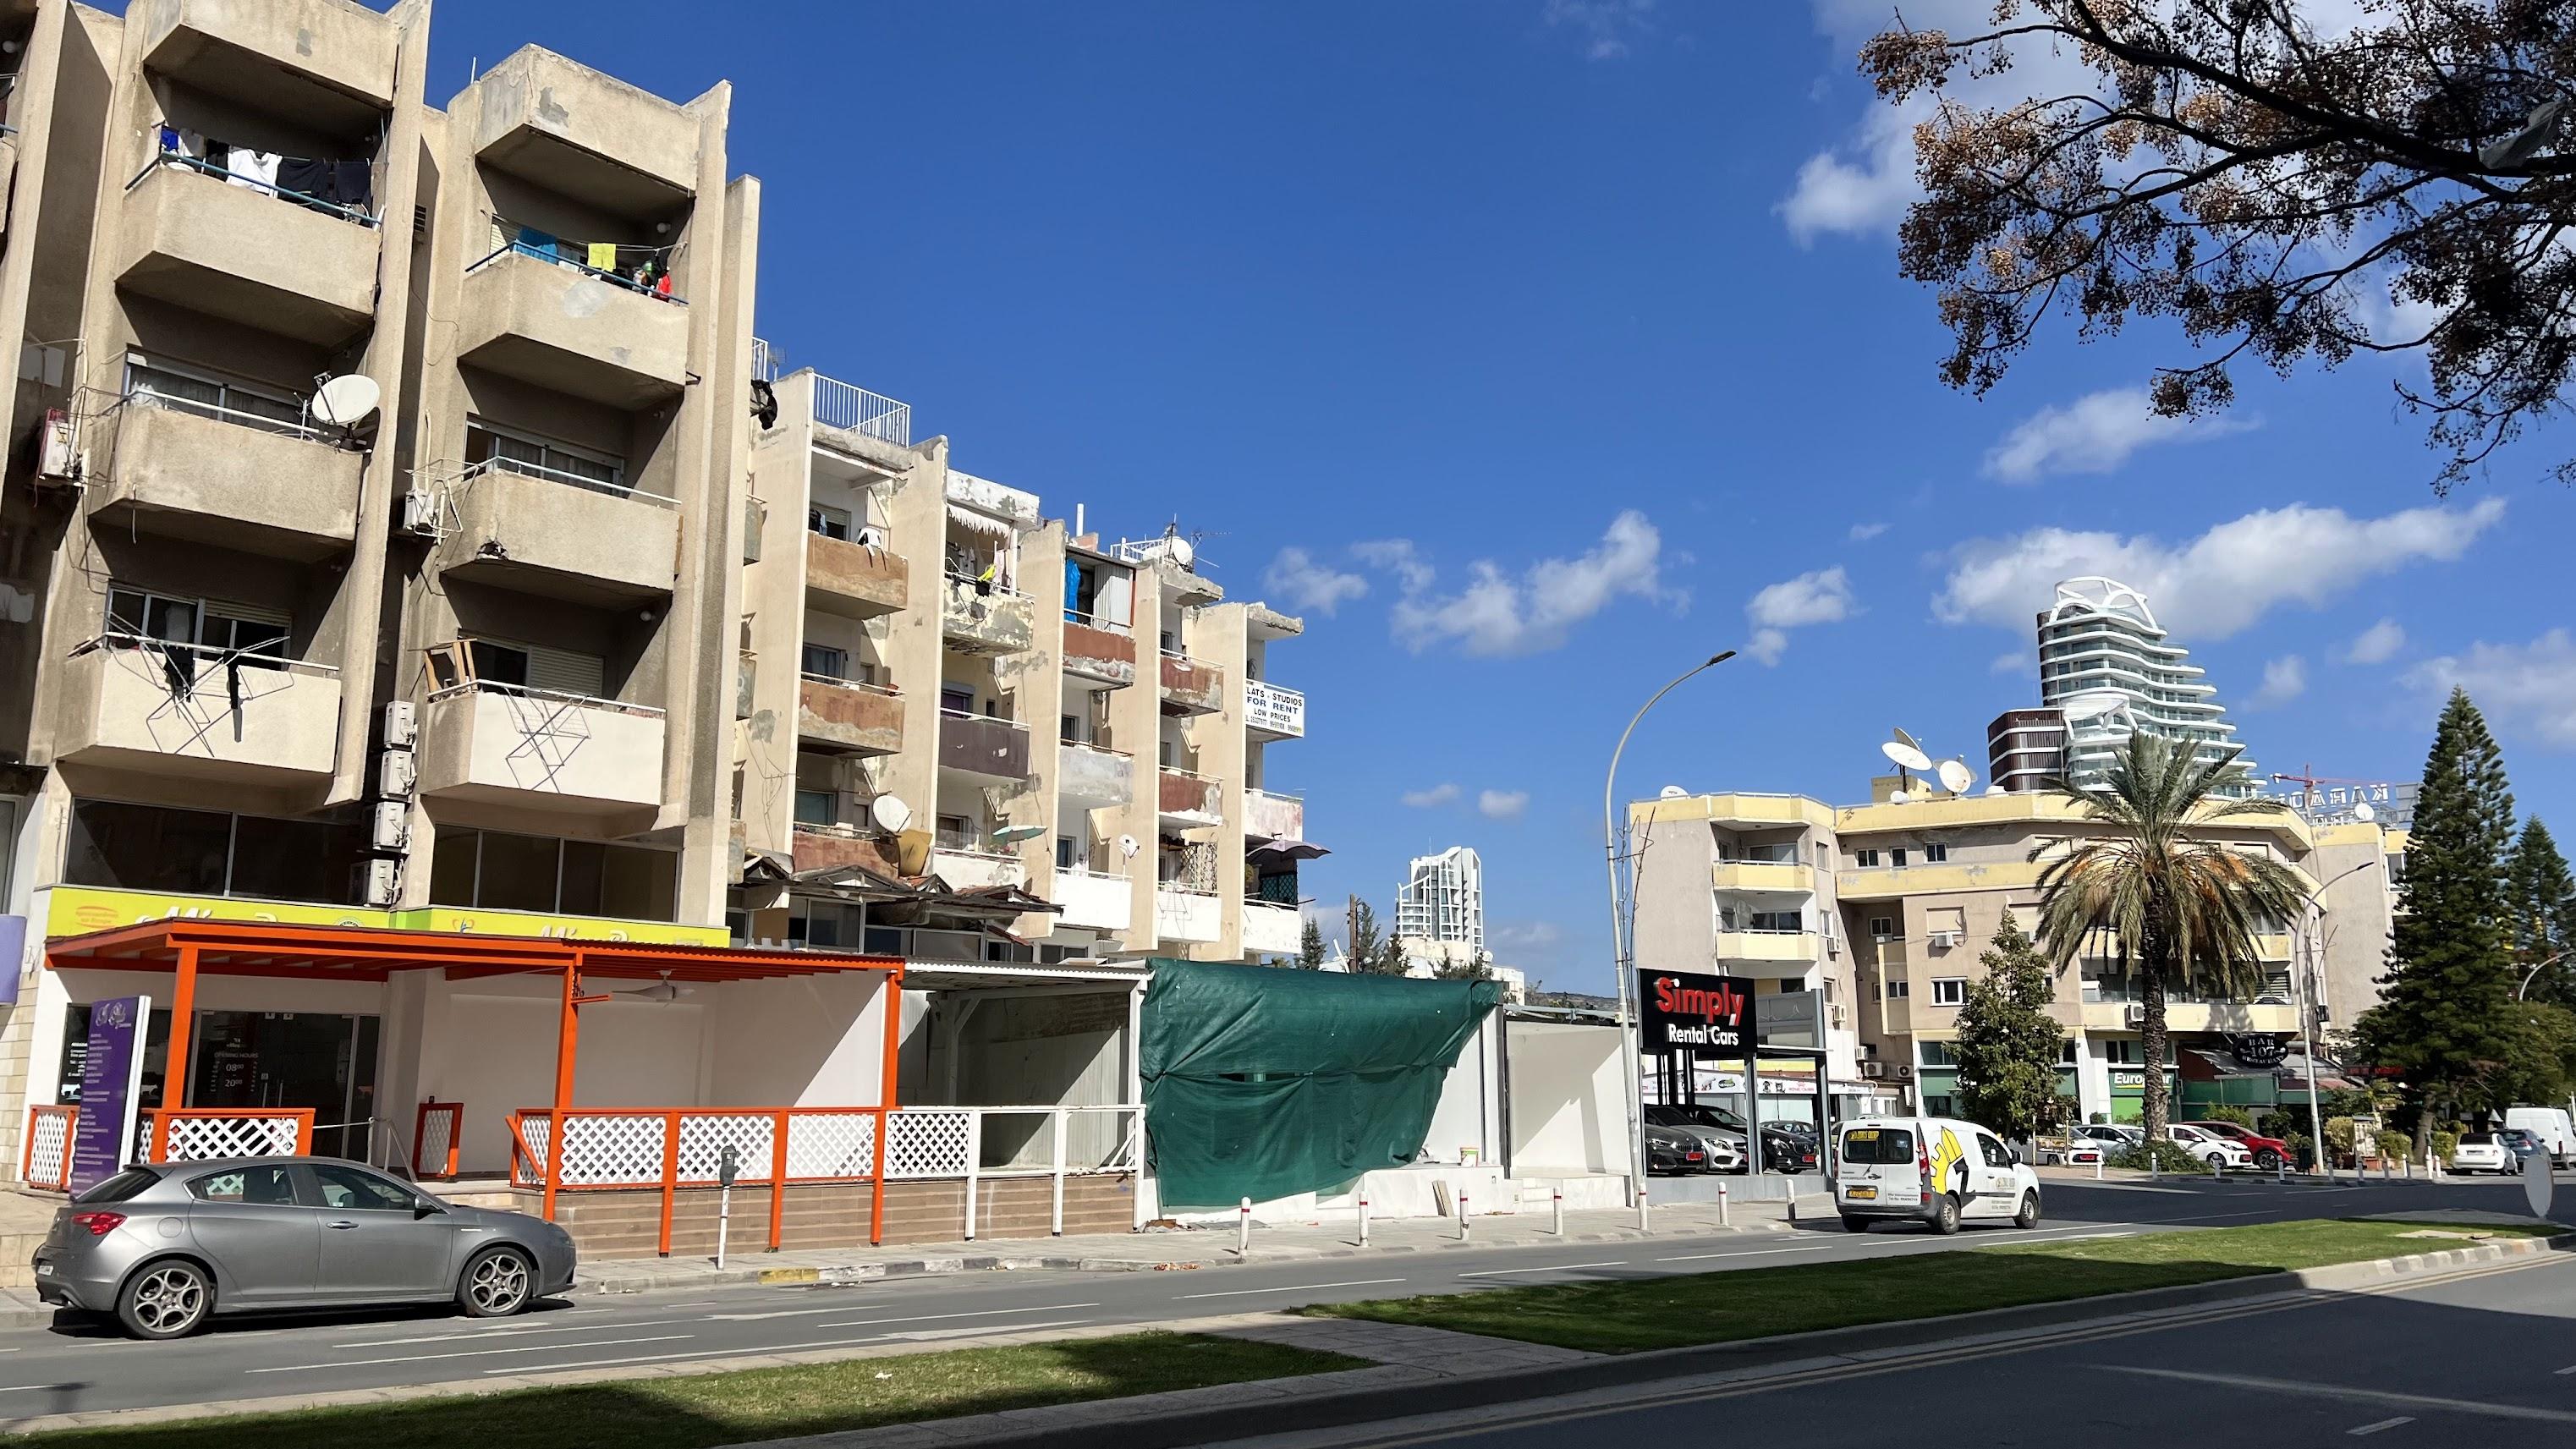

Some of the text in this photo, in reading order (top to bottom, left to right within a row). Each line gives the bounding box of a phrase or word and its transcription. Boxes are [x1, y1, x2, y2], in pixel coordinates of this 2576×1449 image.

[1247, 696, 1299, 714] FOR RENT
[1272, 693, 1302, 706] STUDIOS
[1254, 708, 1266, 716] LOW
[1271, 711, 1291, 722] PRICES
[1654, 977, 1744, 1026] Simply
[1667, 1024, 1738, 1046] Rental Cars
[2251, 1046, 2275, 1057] 107
